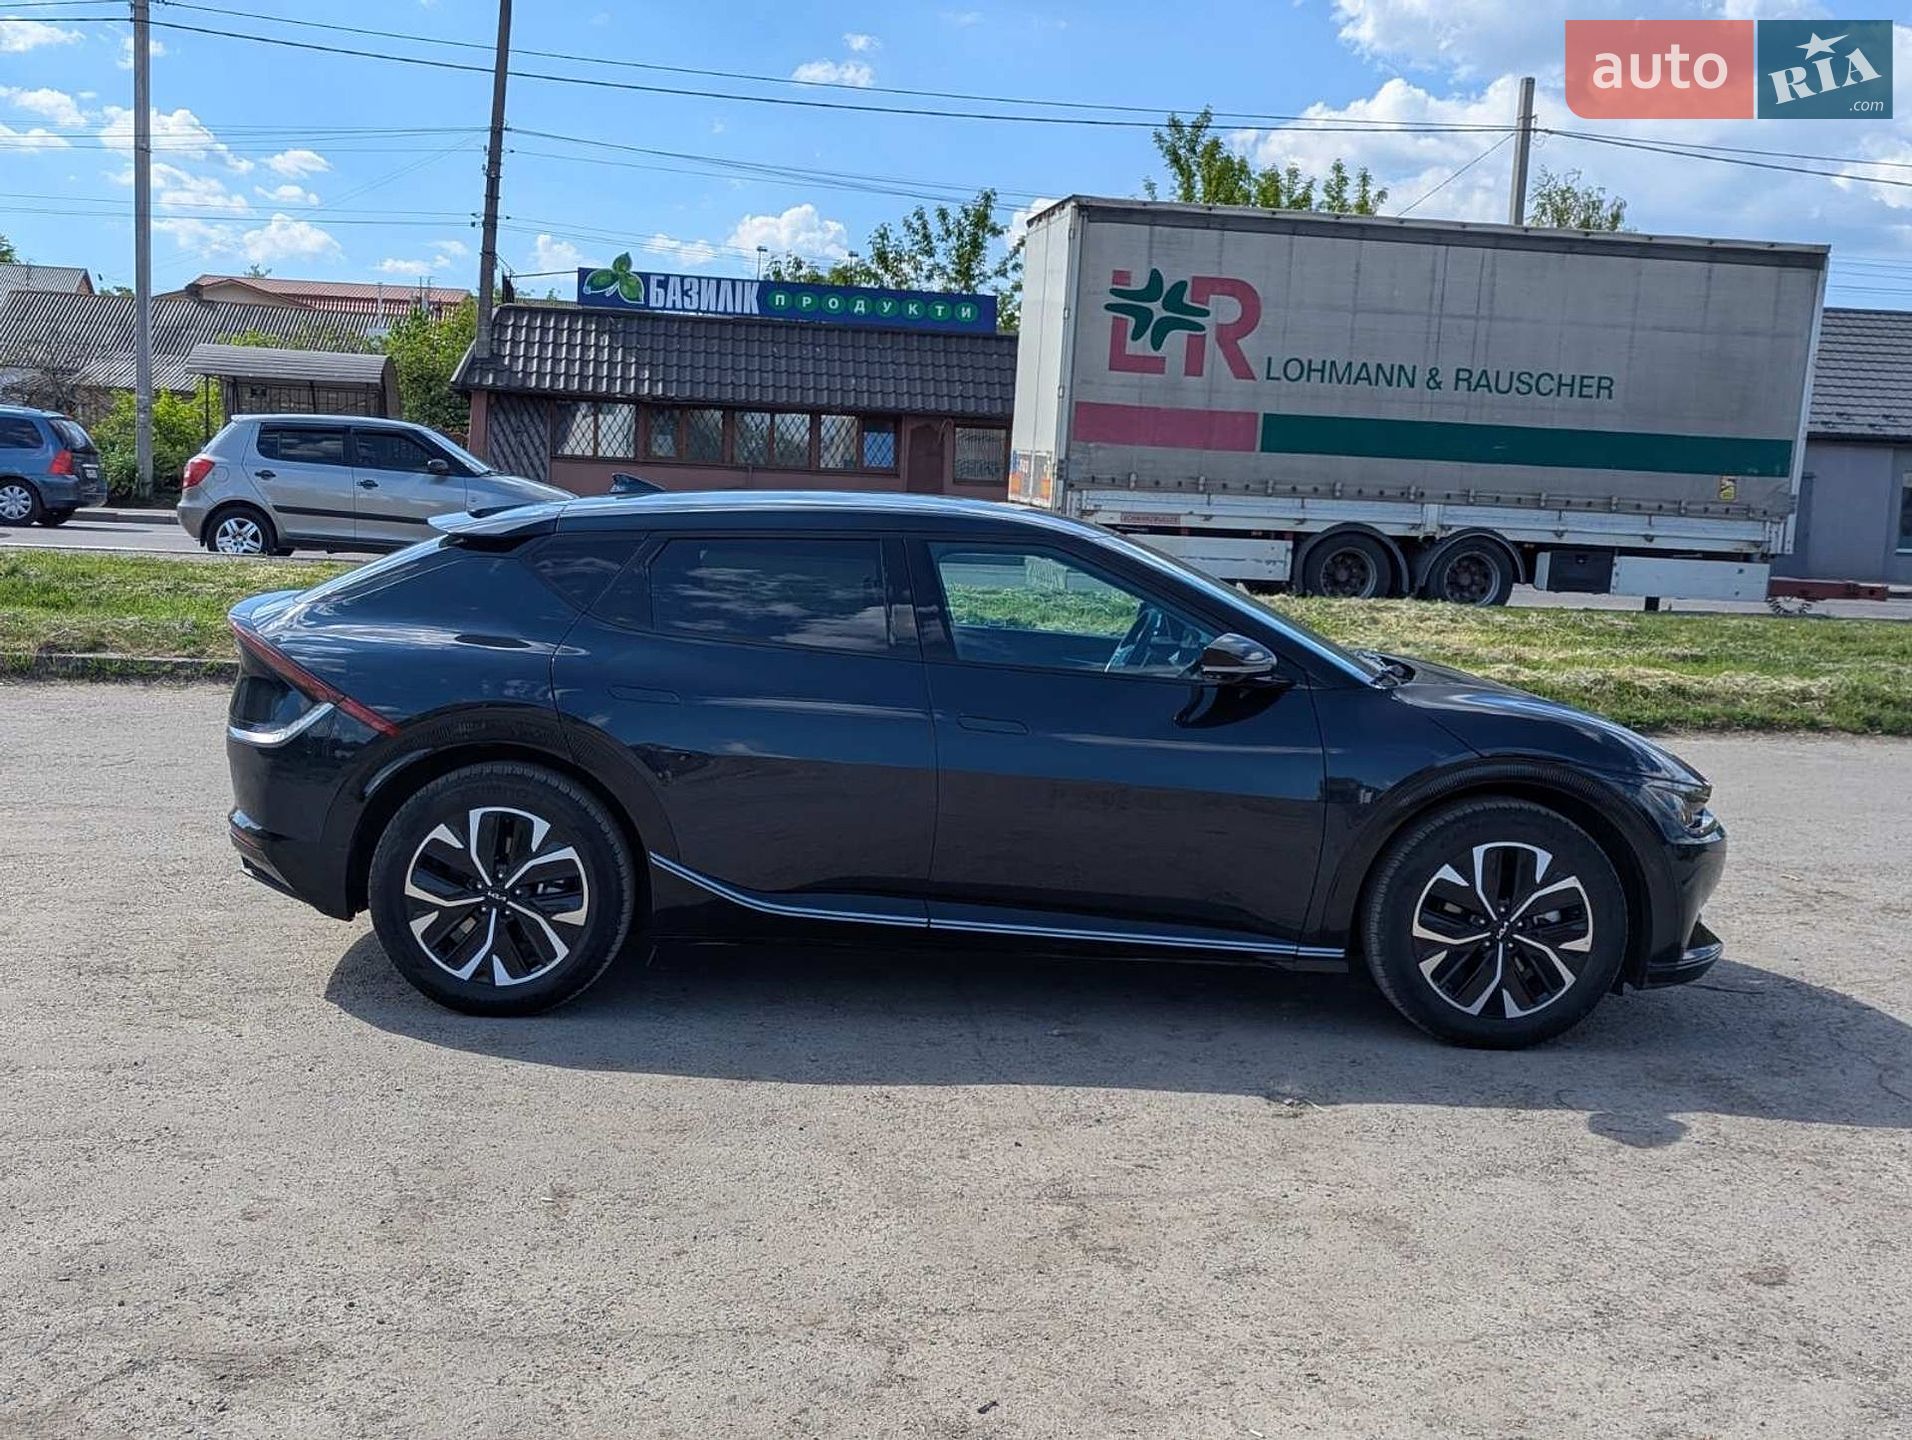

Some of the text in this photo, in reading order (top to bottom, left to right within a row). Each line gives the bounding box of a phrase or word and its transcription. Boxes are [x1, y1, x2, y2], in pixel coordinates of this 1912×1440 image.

[649, 274, 973, 320] БАЗИЛІК ПРОДУКТИ
[1265, 356, 1615, 400] LOHMANN & RAUSCHER
